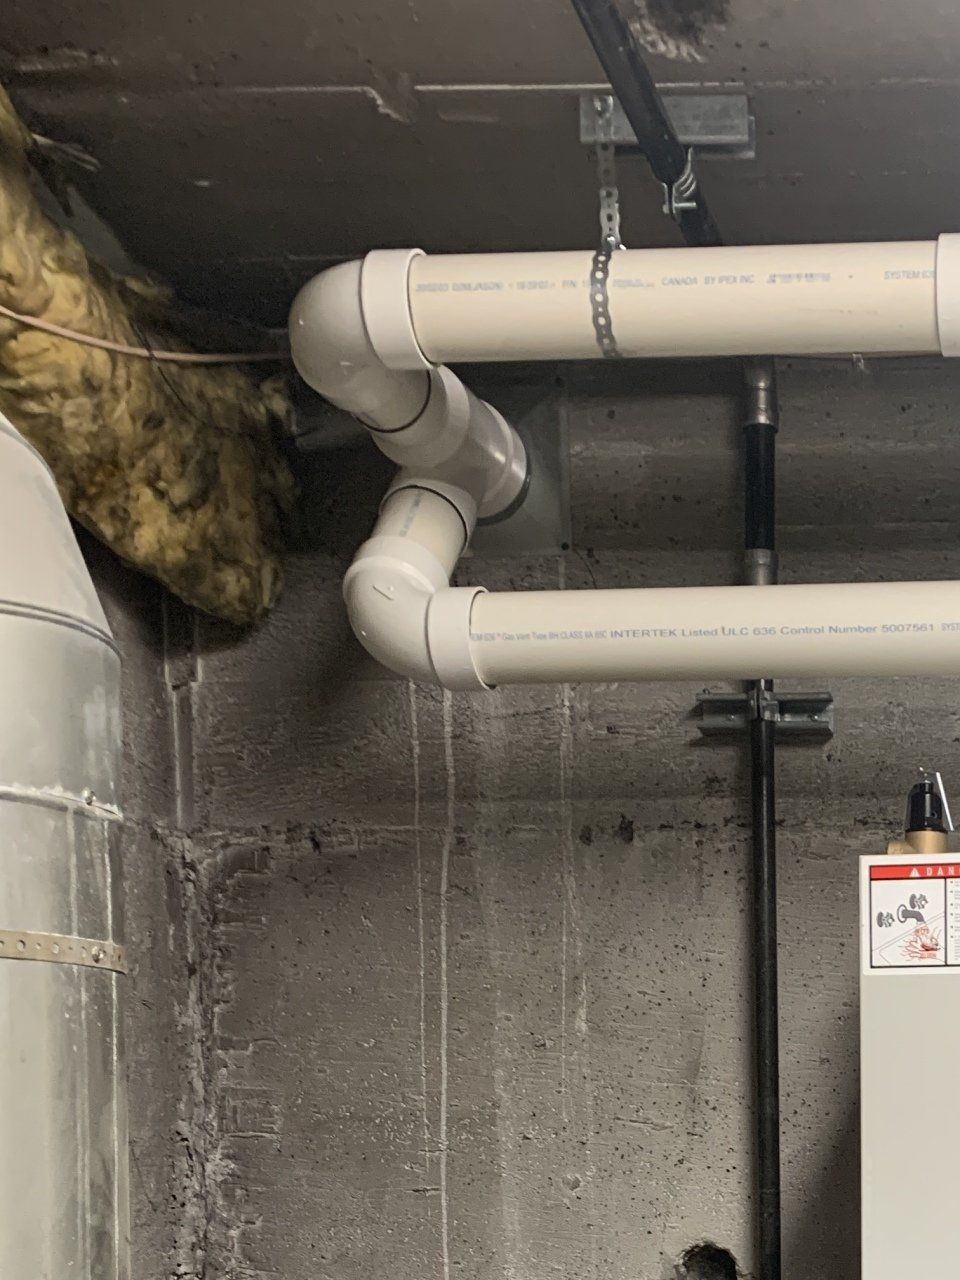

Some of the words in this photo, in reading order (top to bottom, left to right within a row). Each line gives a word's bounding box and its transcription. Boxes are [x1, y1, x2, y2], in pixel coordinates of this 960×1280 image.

[662, 276, 698, 287] CANADA
[884, 270, 921, 281] SYSTEM
[560, 631, 584, 640] CLASS
[610, 628, 678, 639] INTERTEK
[682, 627, 718, 637] Listed
[721, 625, 749, 636] ULC
[753, 626, 777, 636] 636
[780, 625, 825, 636] Control
[828, 624, 878, 635] Number
[881, 623, 935, 633] 5007561
